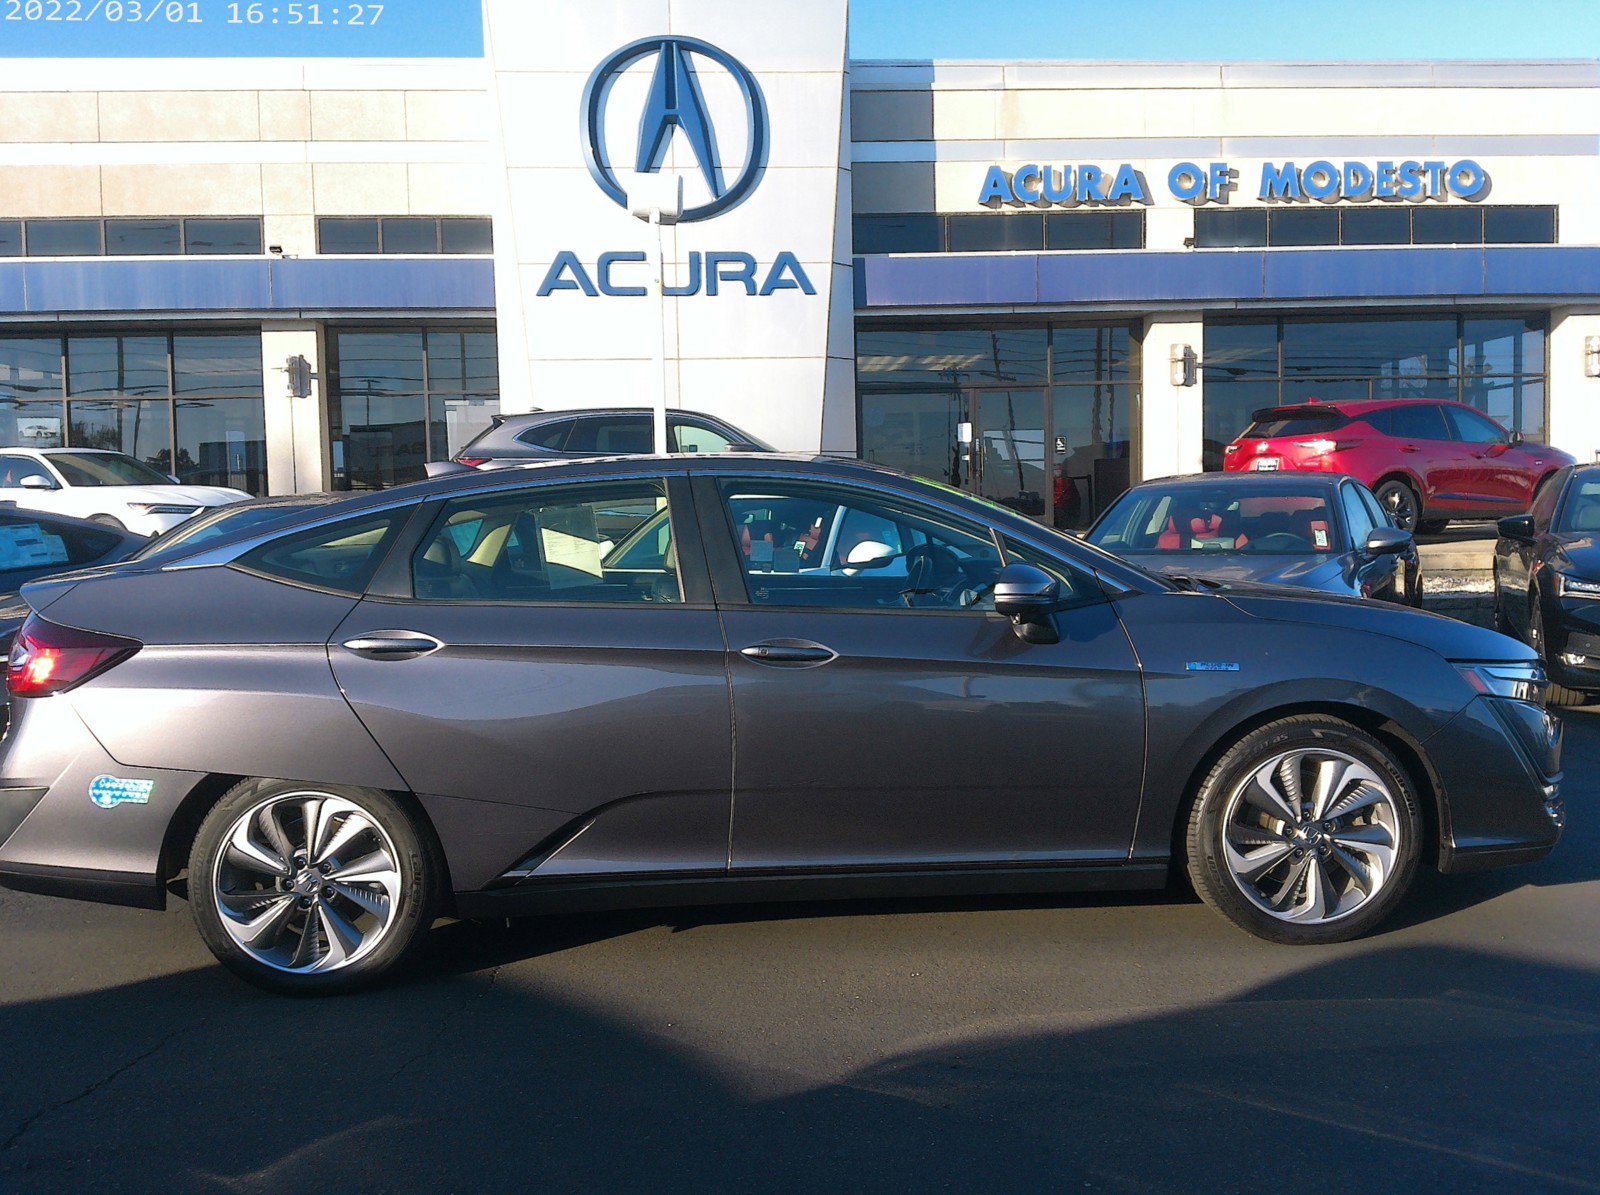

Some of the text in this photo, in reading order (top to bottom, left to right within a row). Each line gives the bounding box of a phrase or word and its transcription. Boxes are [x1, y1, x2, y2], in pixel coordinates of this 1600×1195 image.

[978, 158, 1488, 207] ACURA OF MODESTO
[536, 250, 818, 297] ACURA
